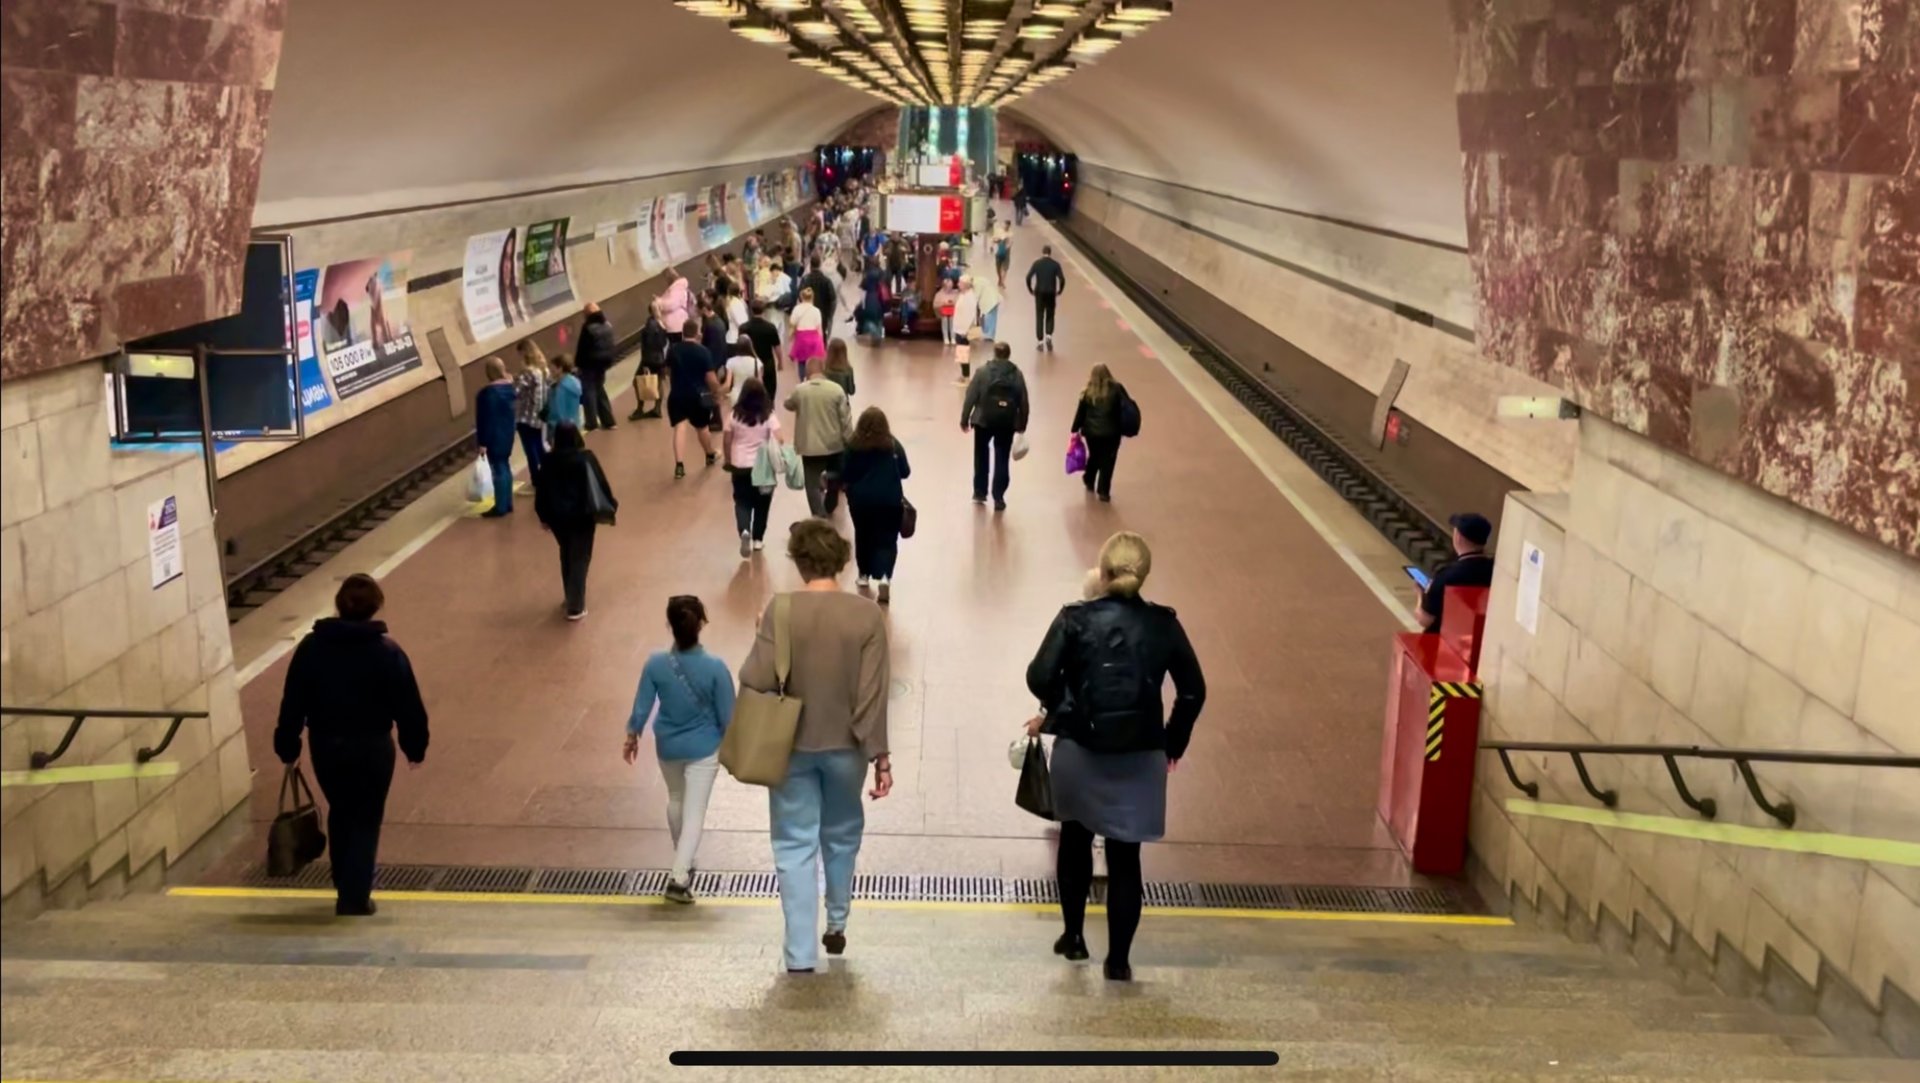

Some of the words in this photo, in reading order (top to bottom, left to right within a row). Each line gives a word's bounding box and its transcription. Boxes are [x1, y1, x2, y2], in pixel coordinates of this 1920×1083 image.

[330, 356, 344, 371] 105
[344, 351, 360, 367] 000
[301, 384, 328, 407] циан
